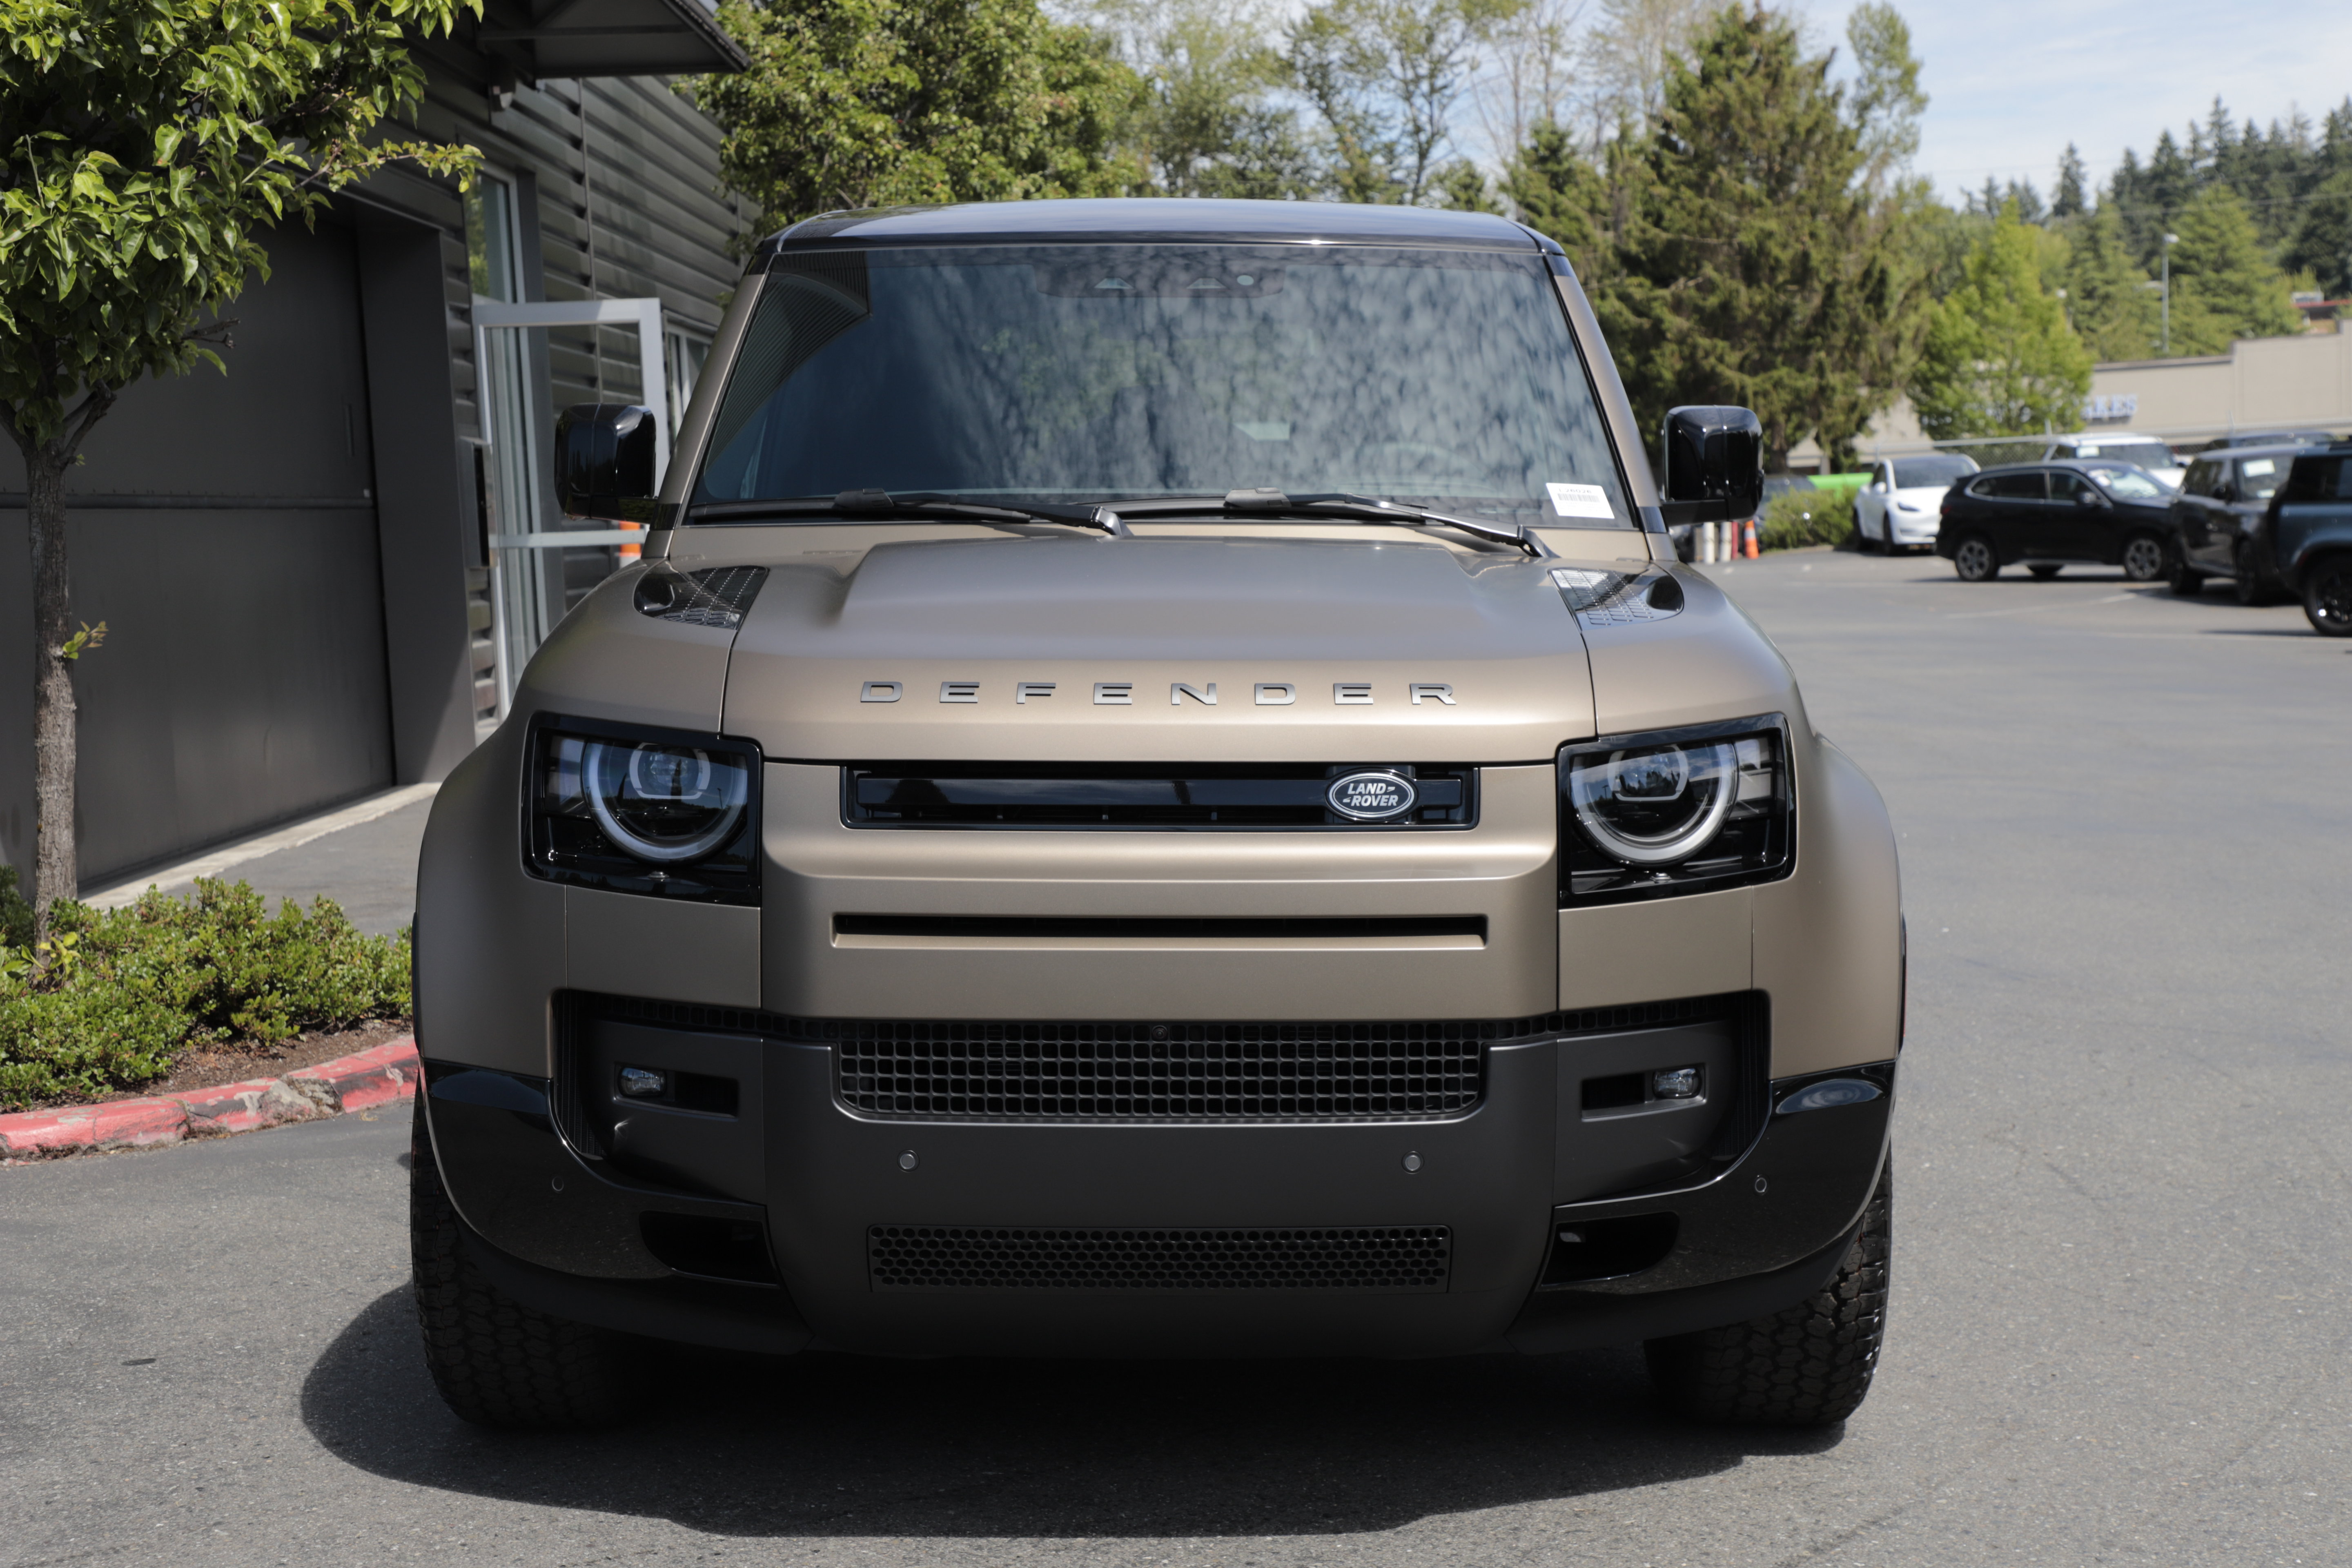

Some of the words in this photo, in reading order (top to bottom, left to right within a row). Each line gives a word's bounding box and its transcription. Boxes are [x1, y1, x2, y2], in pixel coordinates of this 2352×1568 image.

[860, 681, 1457, 705] DEFENDER
[1348, 783, 1386, 794] LAND
[1351, 795, 1399, 806] ROVER
